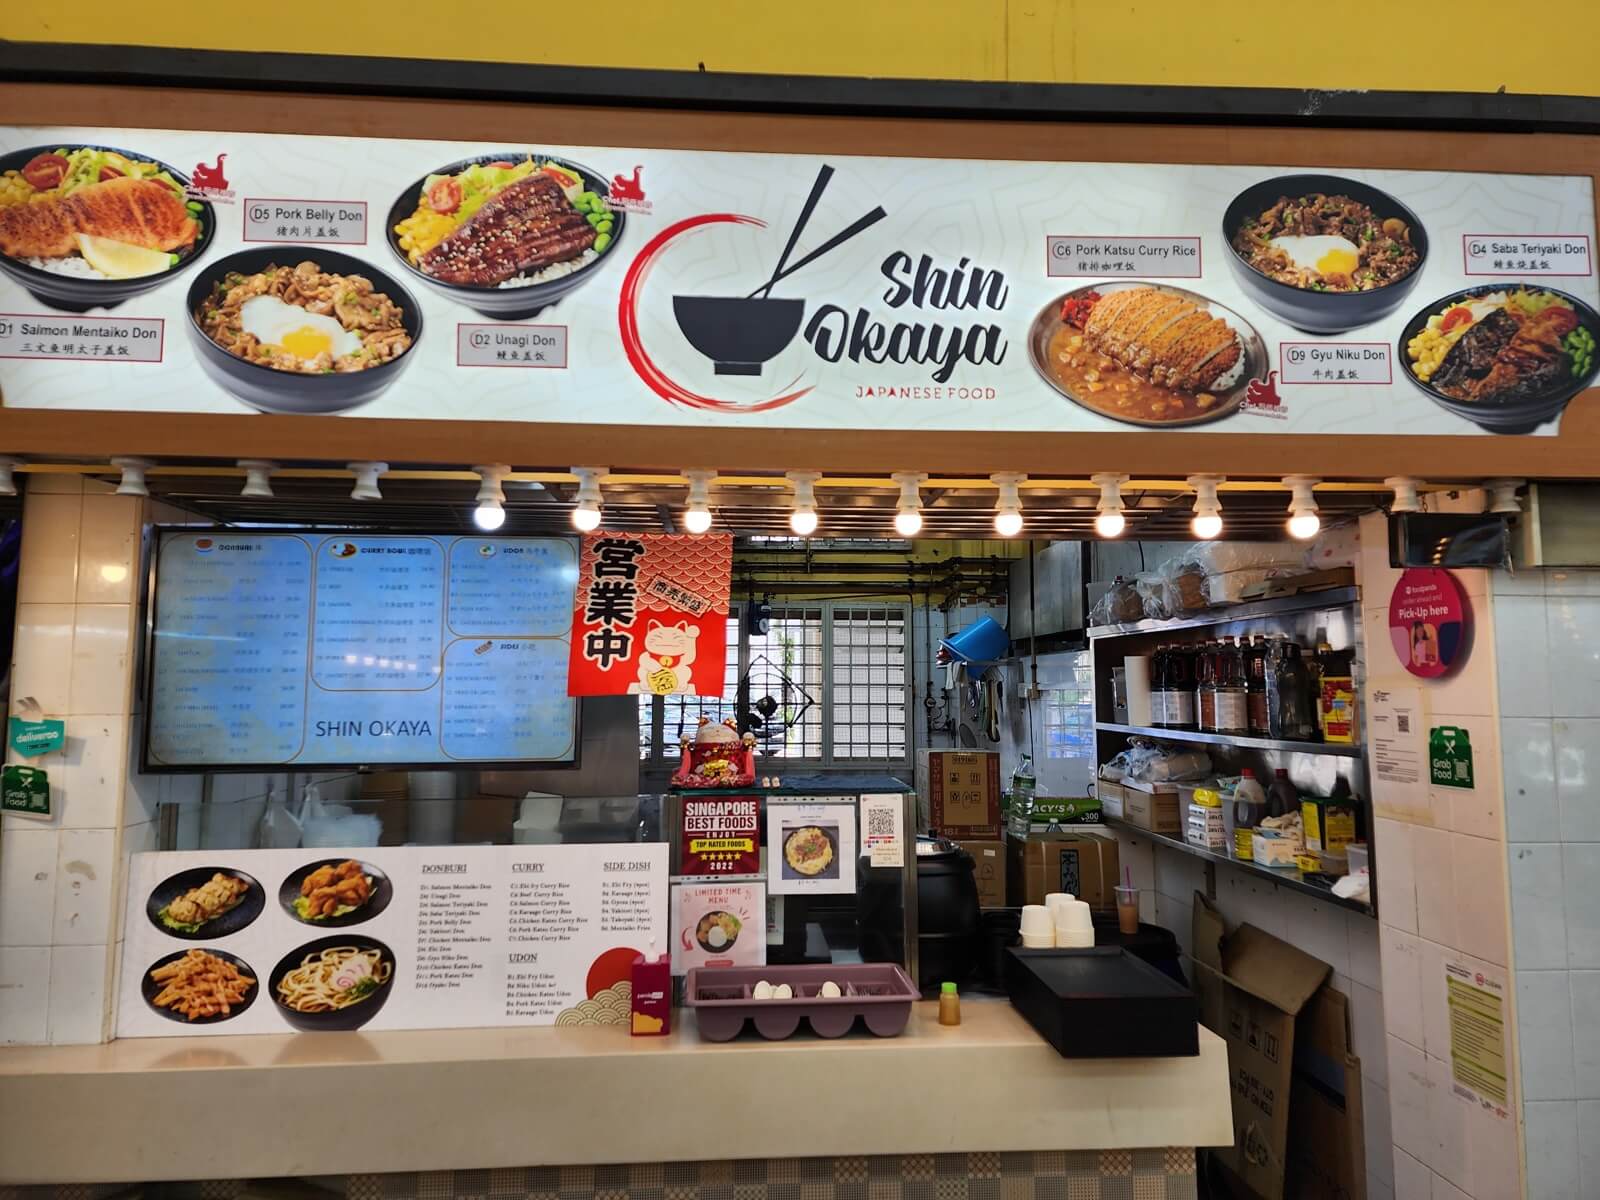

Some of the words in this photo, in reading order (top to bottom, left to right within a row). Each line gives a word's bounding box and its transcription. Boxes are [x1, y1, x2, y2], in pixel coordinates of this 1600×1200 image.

[255, 208, 270, 221] D5
[275, 207, 303, 220] Pork
[306, 208, 335, 223] Belly
[339, 209, 362, 221] Don
[1057, 245, 1071, 256] C6
[1076, 244, 1101, 256] Pork
[1105, 245, 1135, 256] Katsu
[1138, 246, 1169, 258] Curry
[1172, 246, 1196, 256] Rice
[1472, 244, 1487, 255] D4
[1492, 243, 1519, 254] Saba
[1521, 243, 1562, 257] Teriyaki
[1565, 244, 1587, 254] Don
[881, 250, 1008, 311] Shin
[73, 326, 129, 341] Mentaiko
[132, 328, 157, 340] Don
[475, 333, 491, 345] D2
[496, 333, 530, 348] Unagi
[533, 335, 556, 346] Don
[804, 304, 1009, 384] Okaya
[1292, 350, 1305, 361] D9
[1311, 349, 1333, 362] Gyu
[1336, 349, 1361, 360] Niku
[1364, 350, 1386, 360] Don
[856, 386, 942, 400] JAPANESE
[948, 388, 996, 400] FOOD
[1399, 606, 1428, 620] Pick-Up
[1430, 605, 1449, 616] here
[315, 720, 362, 737] SHIN
[368, 720, 432, 737] OKAYA
[1433, 758, 1452, 769] Grab
[1434, 768, 1452, 779] Food
[686, 801, 757, 816] SINGAPORE
[1032, 804, 1065, 813] ACY'S
[687, 818, 714, 832] BEST
[718, 817, 754, 832] FOODS
[706, 831, 736, 839] ENJOY
[709, 841, 726, 849] RATED
[728, 840, 746, 849] FOODS
[422, 863, 468, 874] DONBURI
[512, 863, 545, 873] CURRY
[603, 861, 626, 871] SIDE
[629, 861, 651, 871] DISH
[710, 862, 734, 871] 2022
[695, 887, 723, 897] LIMITED
[726, 886, 742, 896] TIME
[708, 895, 730, 904] MENU
[509, 953, 538, 963] UDON
